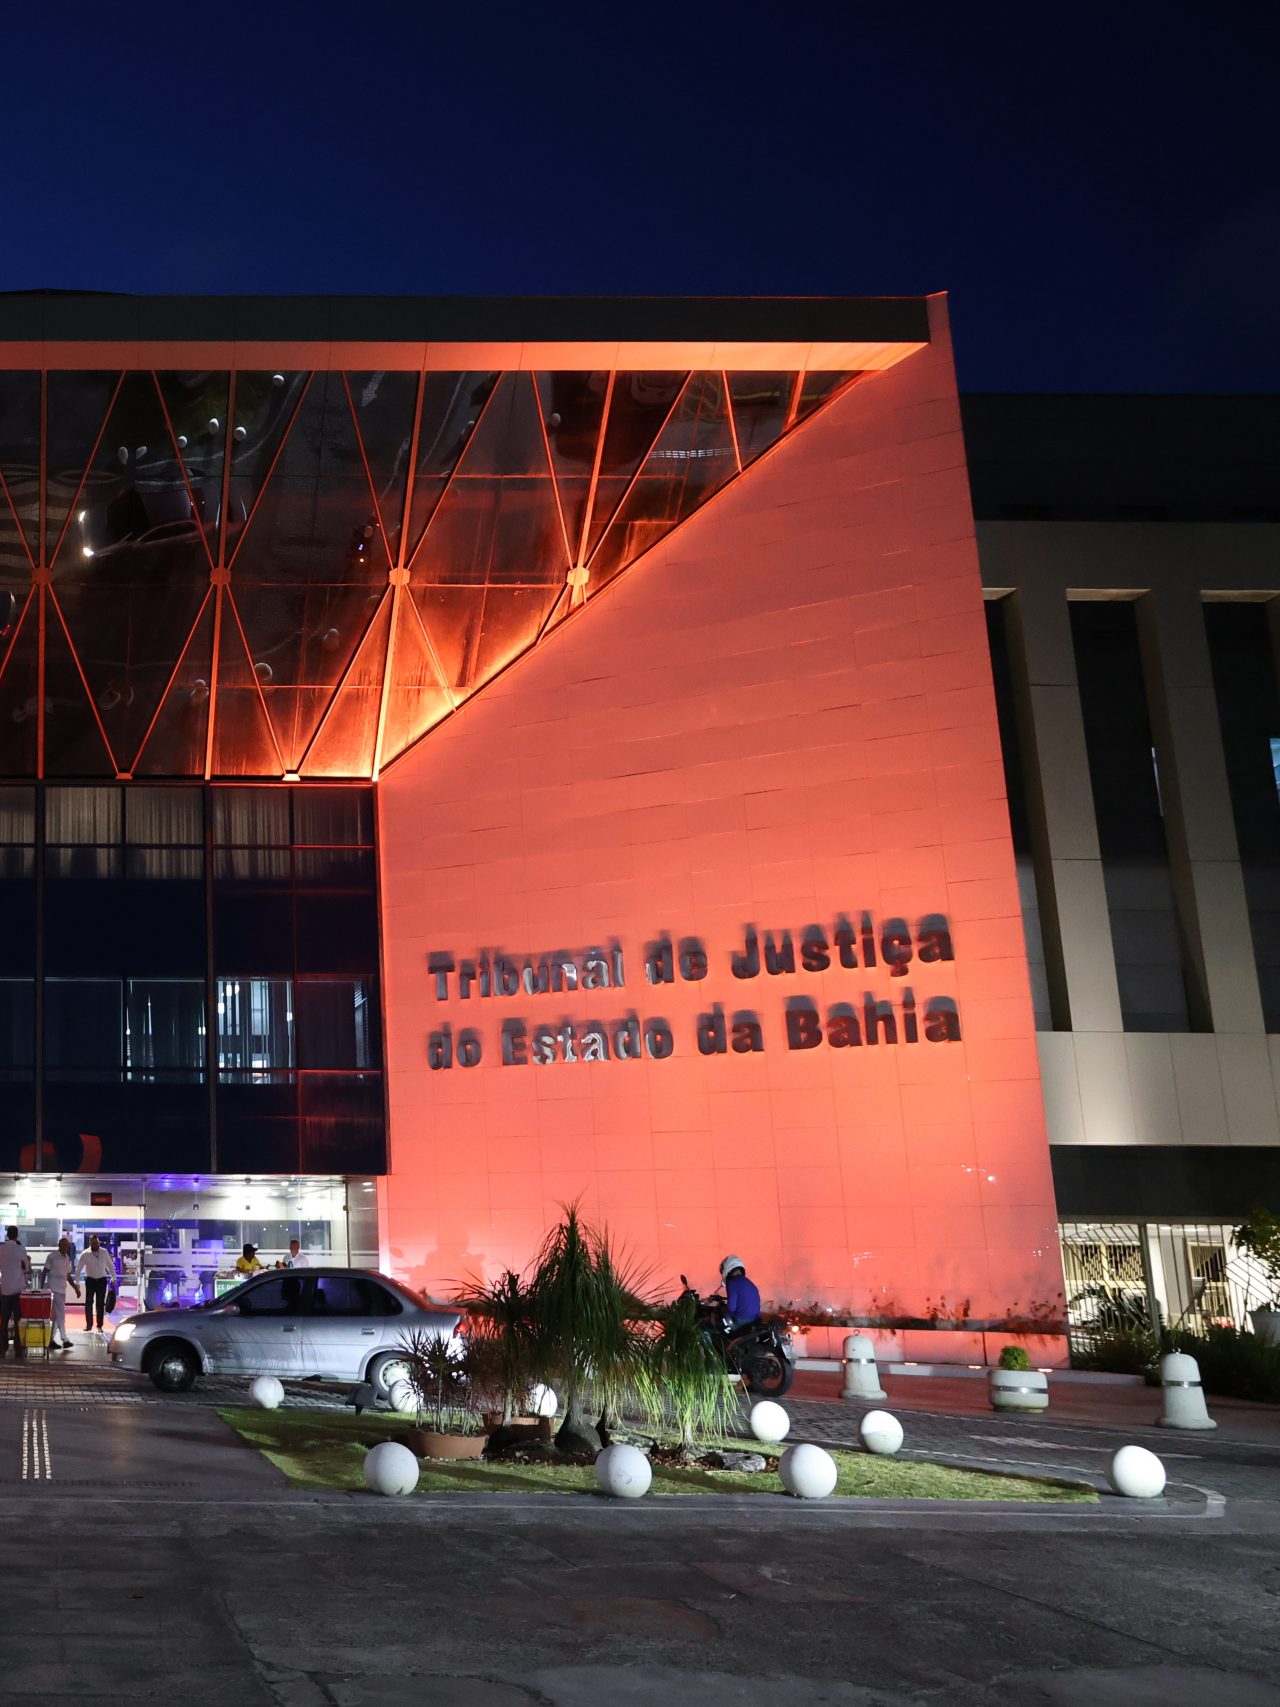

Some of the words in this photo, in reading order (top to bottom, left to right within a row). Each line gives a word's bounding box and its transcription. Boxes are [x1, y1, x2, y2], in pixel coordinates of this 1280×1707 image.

[428, 941, 624, 1000] Tribunal
[646, 933, 707, 984] de
[731, 914, 954, 979] Justiça
[429, 1024, 481, 1069] do
[502, 1011, 673, 1065] Estado
[698, 1005, 764, 1055] da
[786, 990, 961, 1049] Bahia
